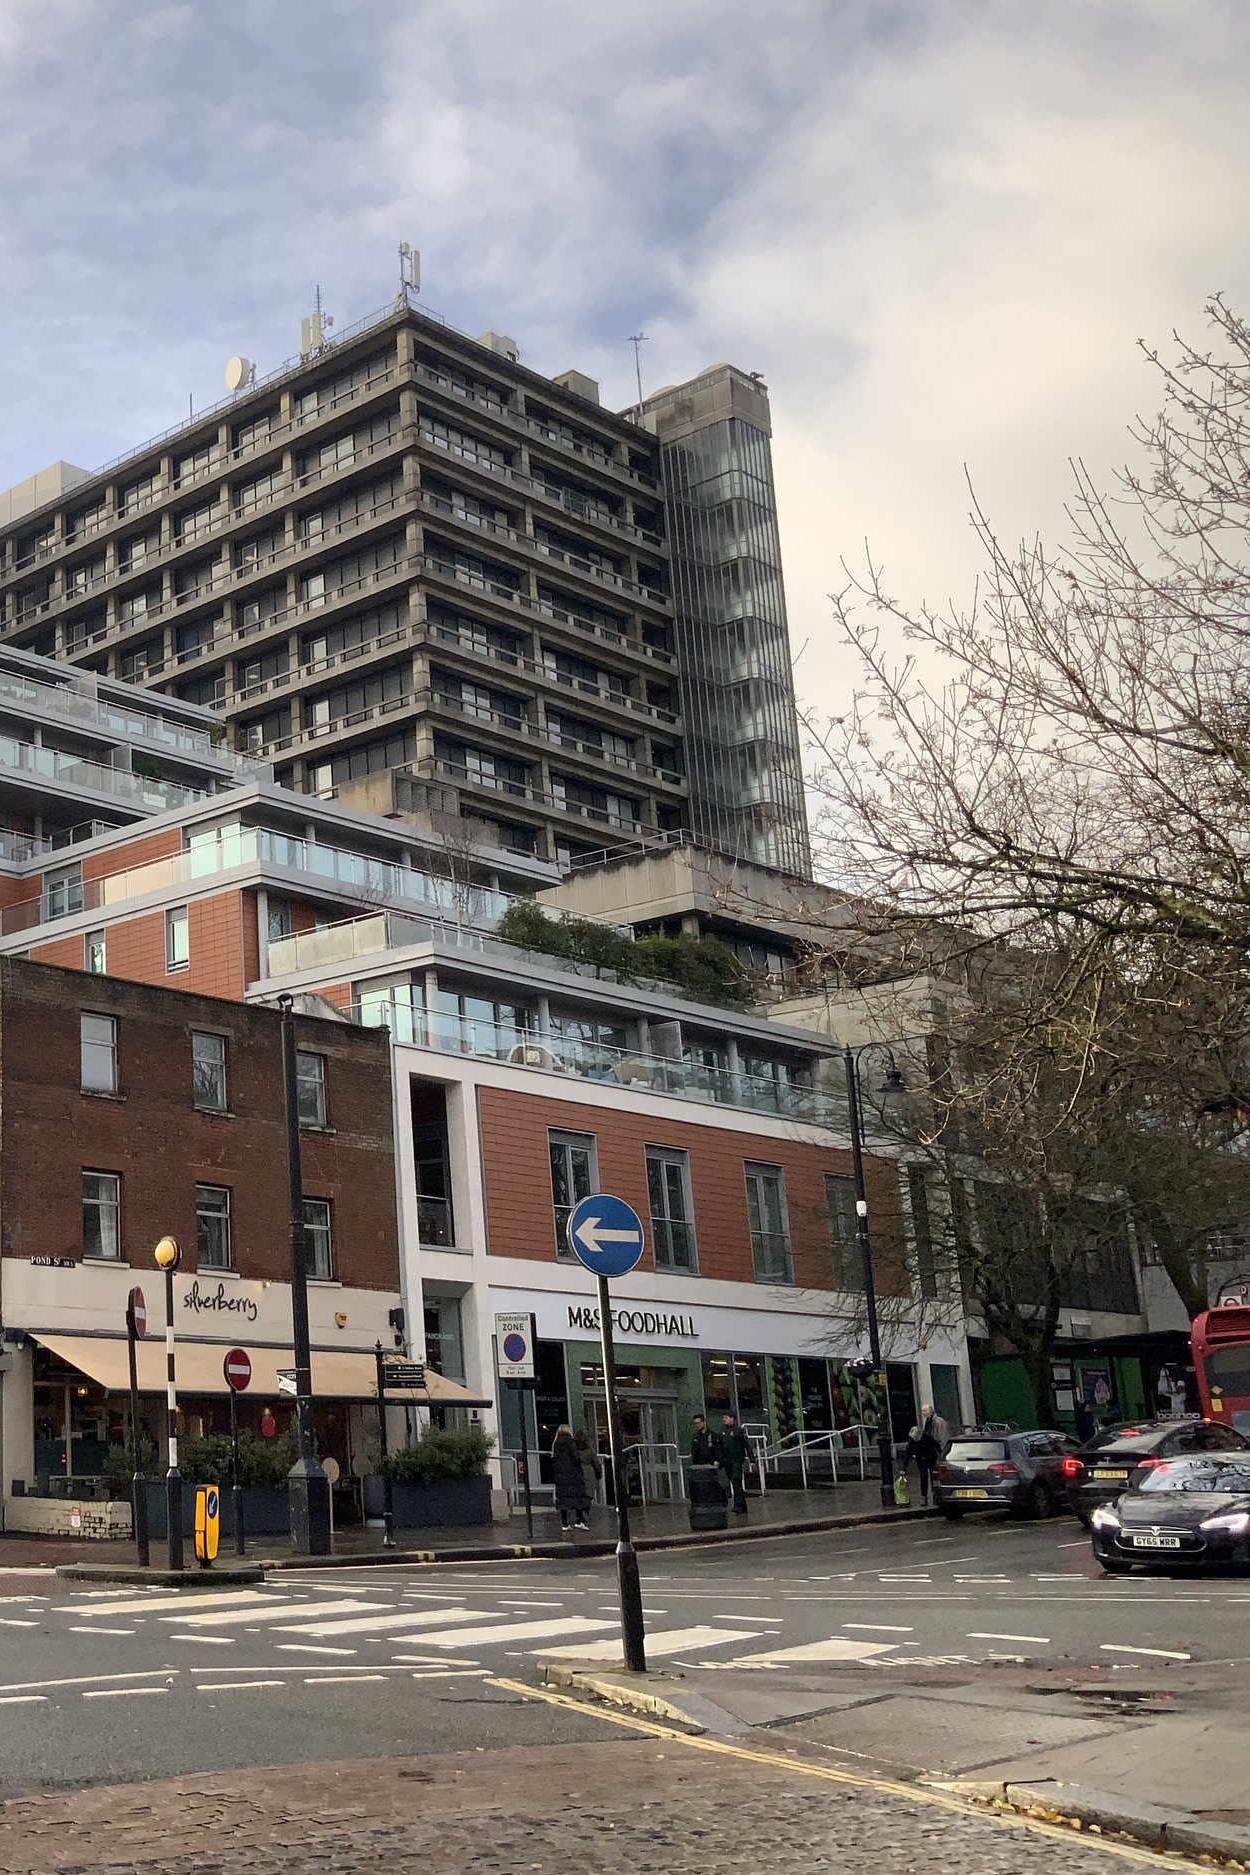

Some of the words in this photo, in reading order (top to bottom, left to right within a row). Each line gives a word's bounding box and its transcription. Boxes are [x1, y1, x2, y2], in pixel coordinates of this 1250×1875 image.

[31, 1256, 51, 1266] POND
[183, 1280, 258, 1321] silverberry
[502, 1323, 525, 1332] ZONE
[610, 1309, 699, 1337] FOODHALL
[1136, 1537, 1158, 1546] GY65
